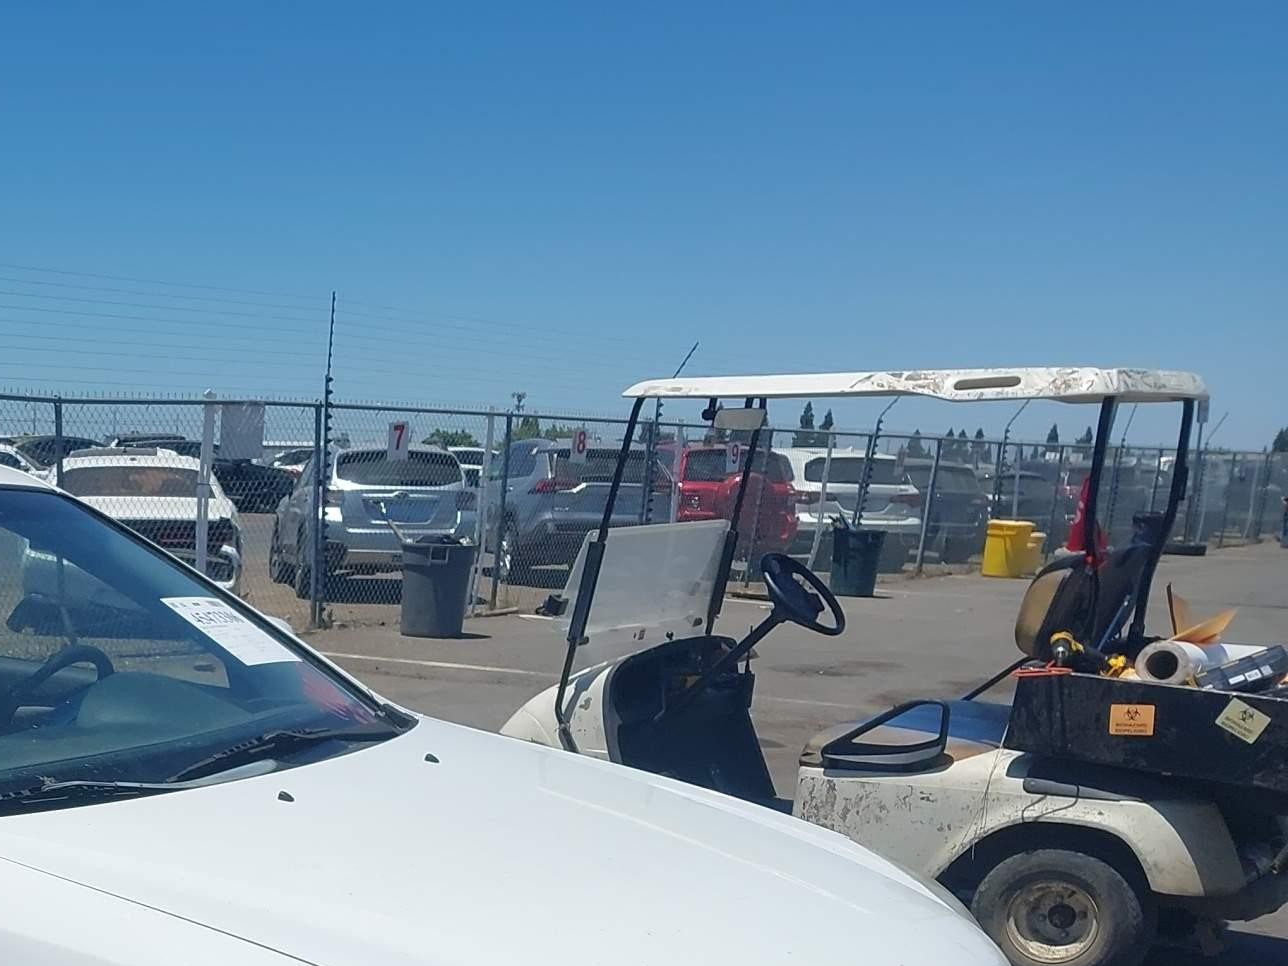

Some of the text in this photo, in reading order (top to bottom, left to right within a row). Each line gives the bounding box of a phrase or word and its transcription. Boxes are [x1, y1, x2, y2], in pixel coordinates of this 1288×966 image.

[393, 424, 405, 450] 7
[577, 431, 586, 454] 8
[732, 444, 739, 464] 9
